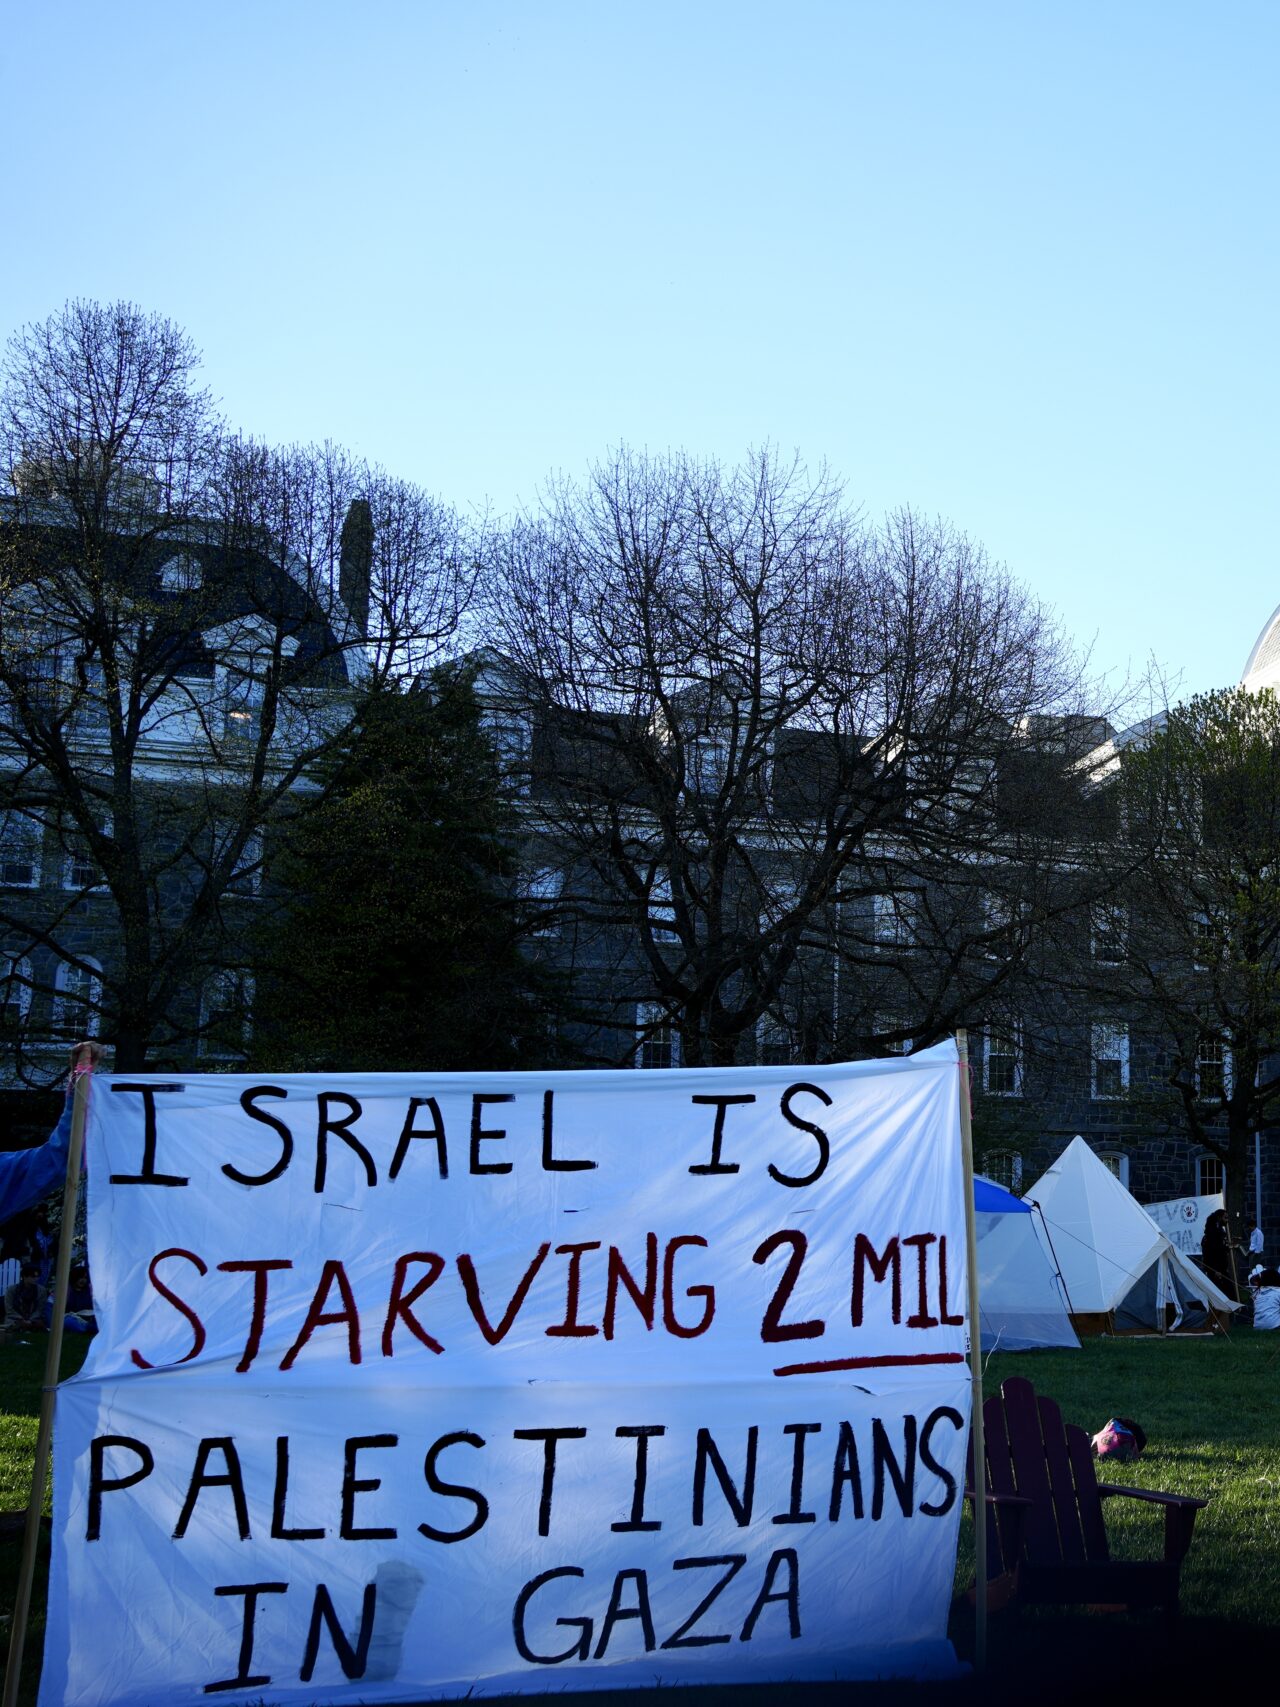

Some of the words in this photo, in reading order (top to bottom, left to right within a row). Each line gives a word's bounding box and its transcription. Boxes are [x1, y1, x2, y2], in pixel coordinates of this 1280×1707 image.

[110, 1083, 597, 1193] ISRAEL
[689, 1083, 833, 1188] IS
[132, 1232, 716, 1372] STARVING
[752, 1230, 825, 1343] 2
[851, 1232, 964, 1329] MIL
[86, 1406, 964, 1543] PALESTINIANS
[205, 1582, 377, 1693] IN
[513, 1548, 801, 1665] GAZA
